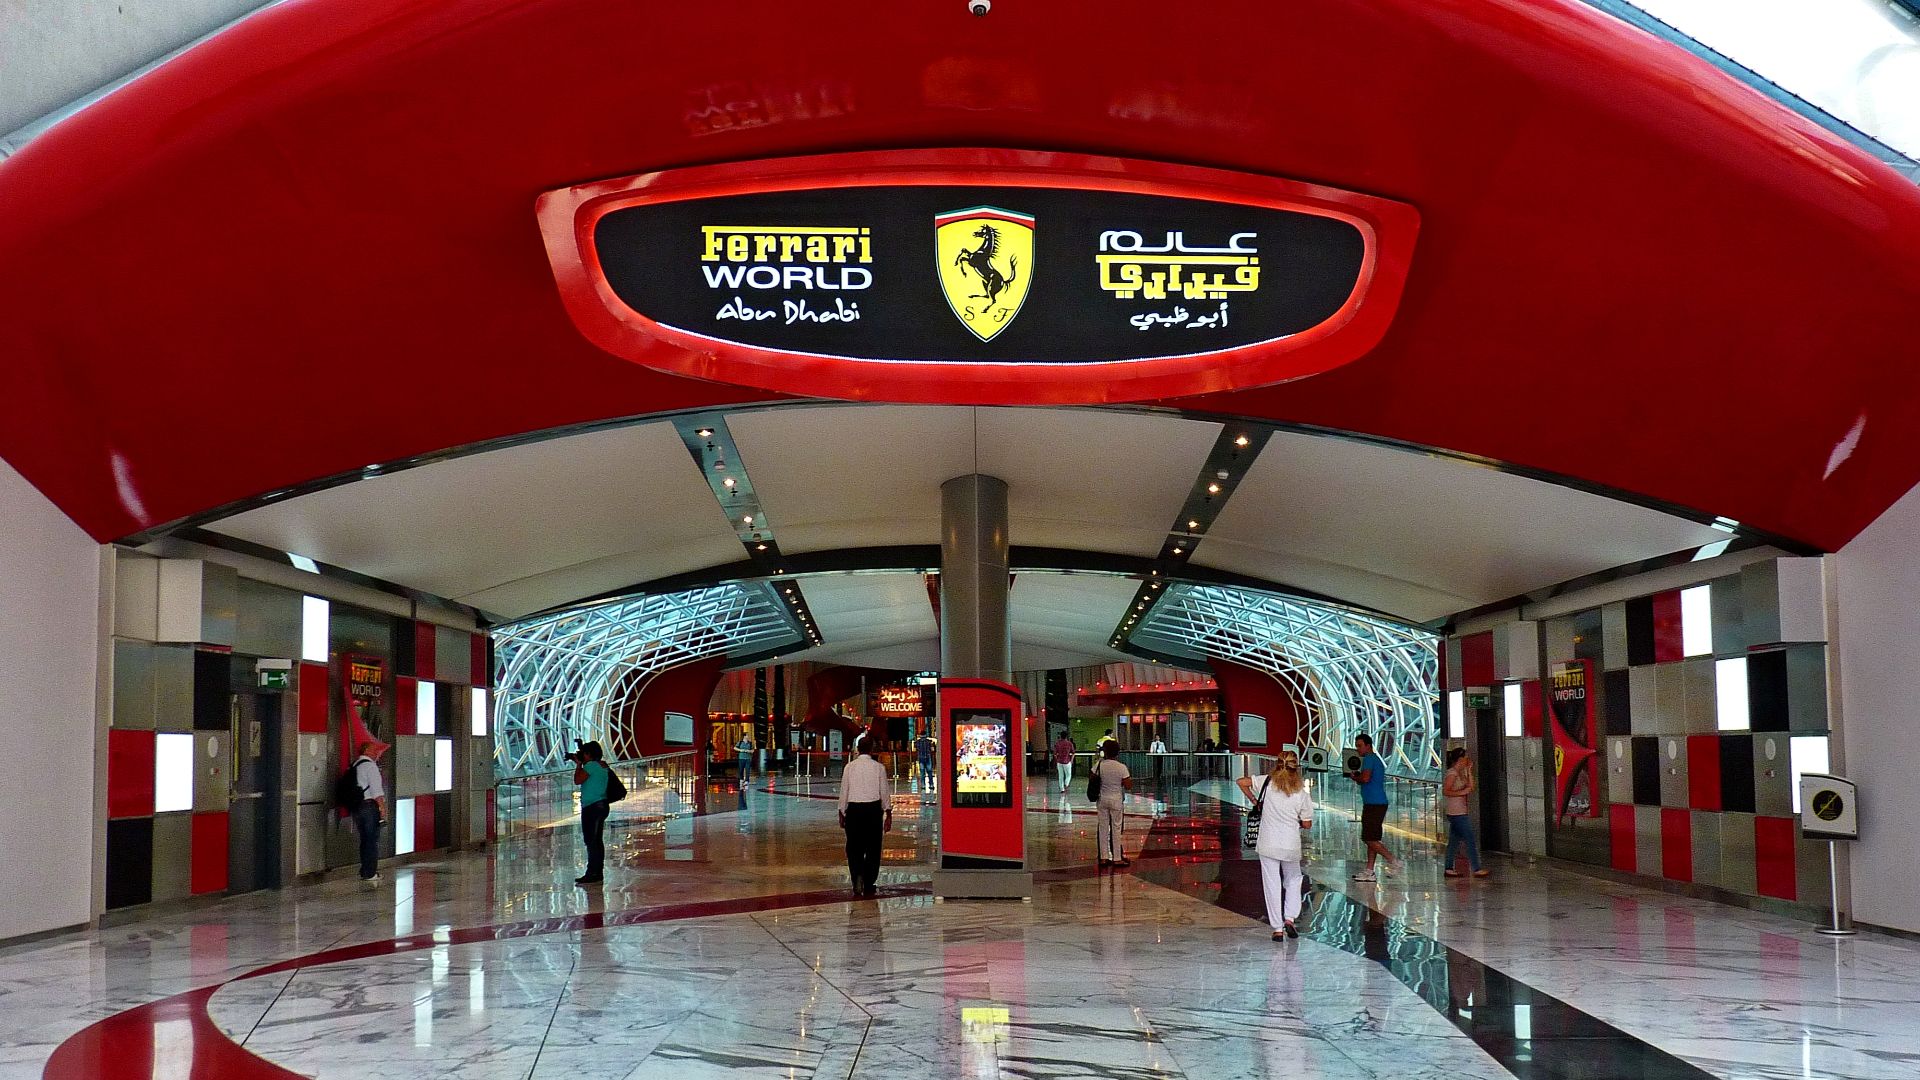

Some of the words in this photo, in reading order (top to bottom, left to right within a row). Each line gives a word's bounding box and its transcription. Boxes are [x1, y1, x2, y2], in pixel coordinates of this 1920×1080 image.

[701, 226, 873, 263] Ferrari
[1100, 231, 1257, 253] عالم
[702, 265, 873, 290] WORLD
[1096, 255, 1260, 299] فيراري
[716, 296, 776, 321] Abu
[783, 298, 860, 325] Dhabi
[964, 306, 975, 321] S
[1130, 306, 1189, 330] ظبي
[1186, 302, 1228, 328] أبو
[352, 683, 381, 697] WORLD
[1554, 688, 1585, 701] WORLD
[880, 703, 923, 712] WELCOME
